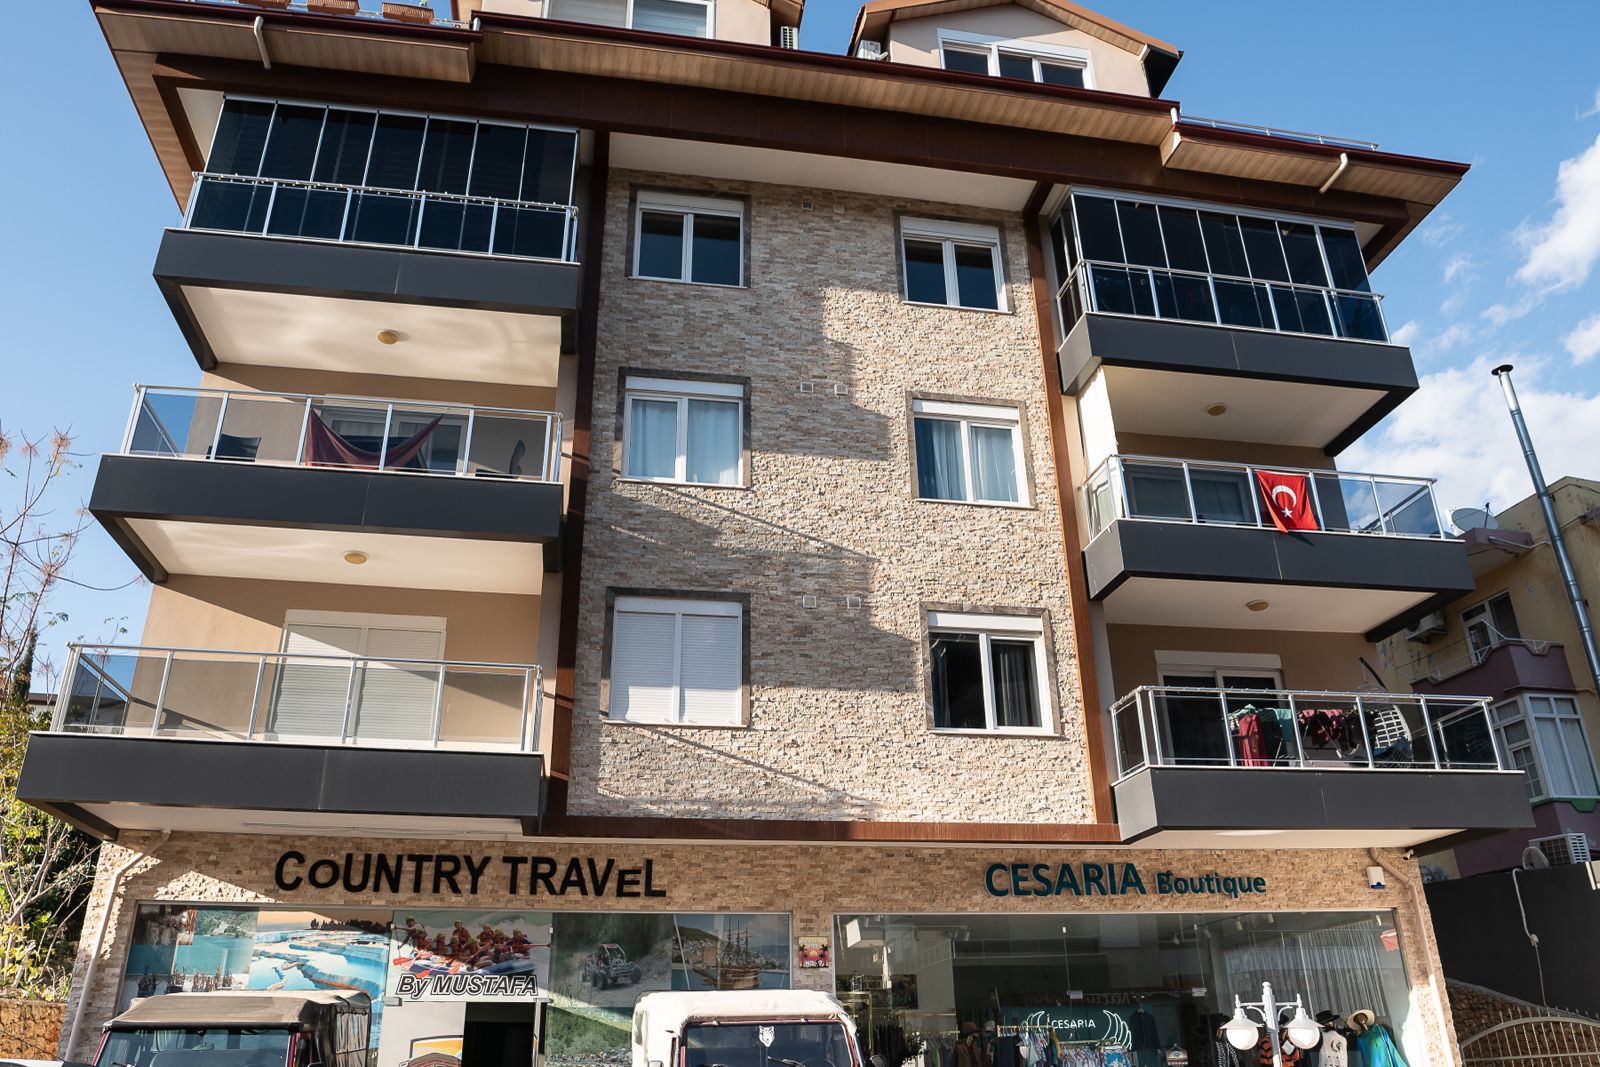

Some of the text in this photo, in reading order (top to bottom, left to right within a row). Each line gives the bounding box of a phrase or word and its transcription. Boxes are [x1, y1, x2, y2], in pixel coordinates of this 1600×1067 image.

[275, 851, 667, 898] COUNTRY TRAVEL
[984, 862, 1267, 898] CESARIA Boutique
[397, 974, 538, 999] By MUSTAFA
[1051, 1019, 1096, 1029] CESARIA
